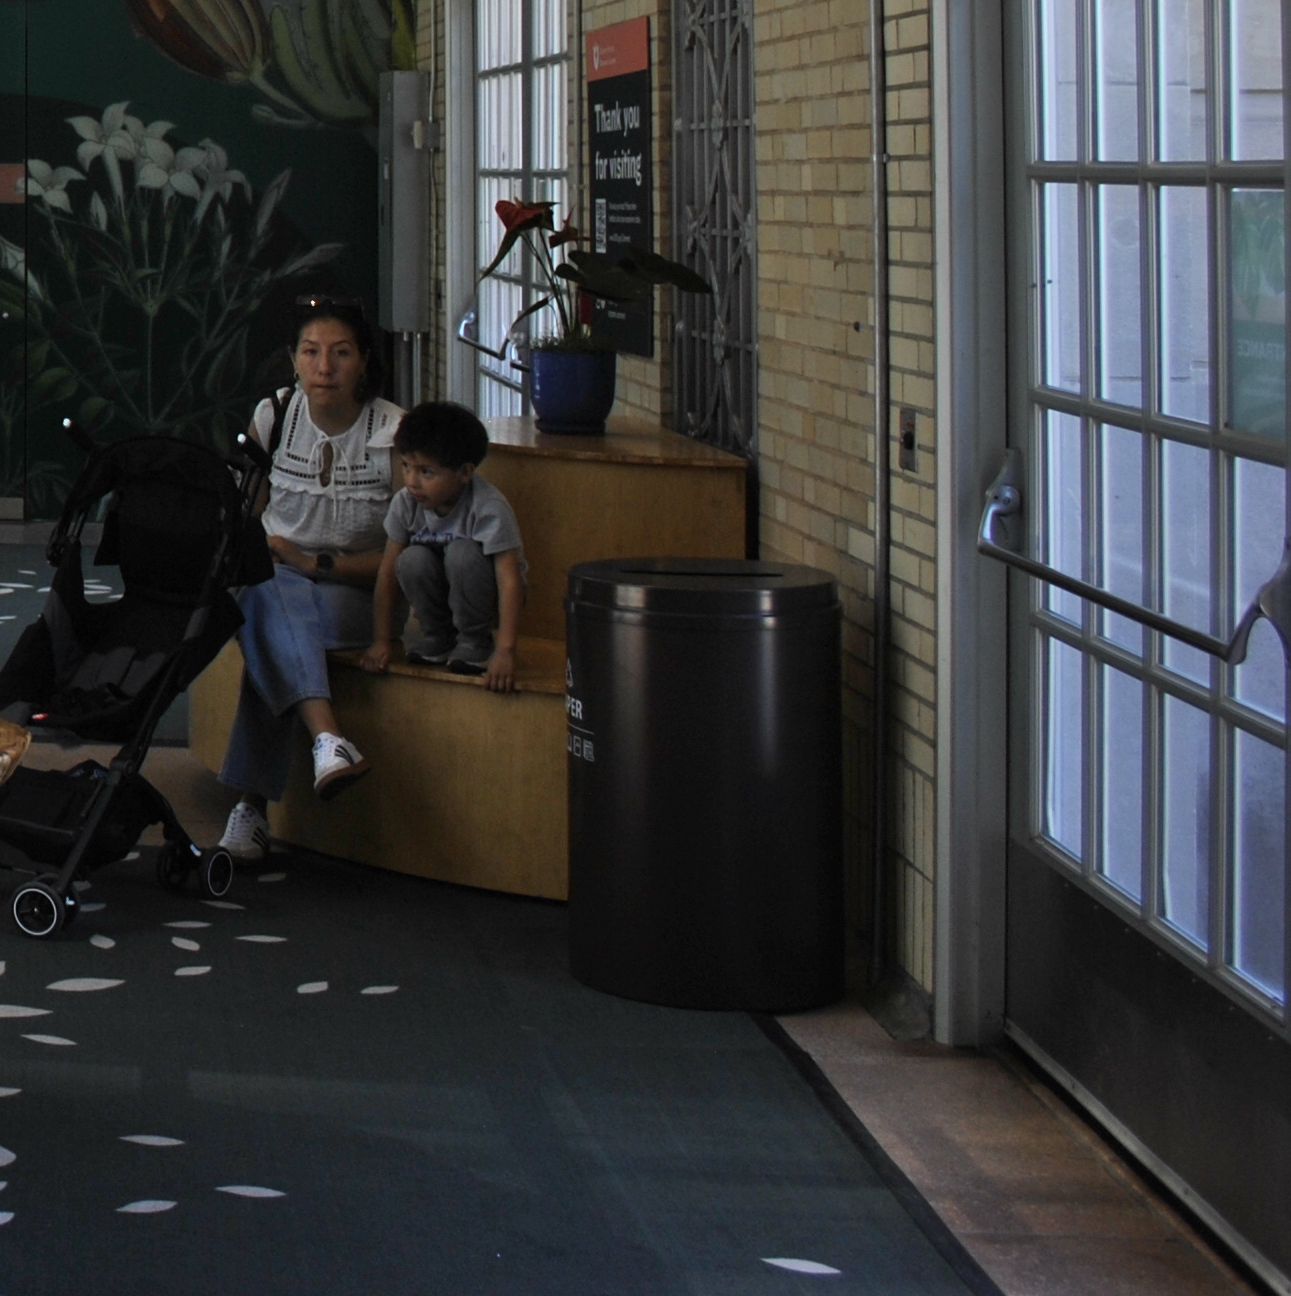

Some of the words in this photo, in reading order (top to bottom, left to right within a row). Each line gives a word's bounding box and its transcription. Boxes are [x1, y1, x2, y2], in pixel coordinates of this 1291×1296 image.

[594, 101, 622, 134] Thank
[623, 105, 640, 137] you
[595, 151, 608, 180] for
[609, 149, 642, 186] visiting
